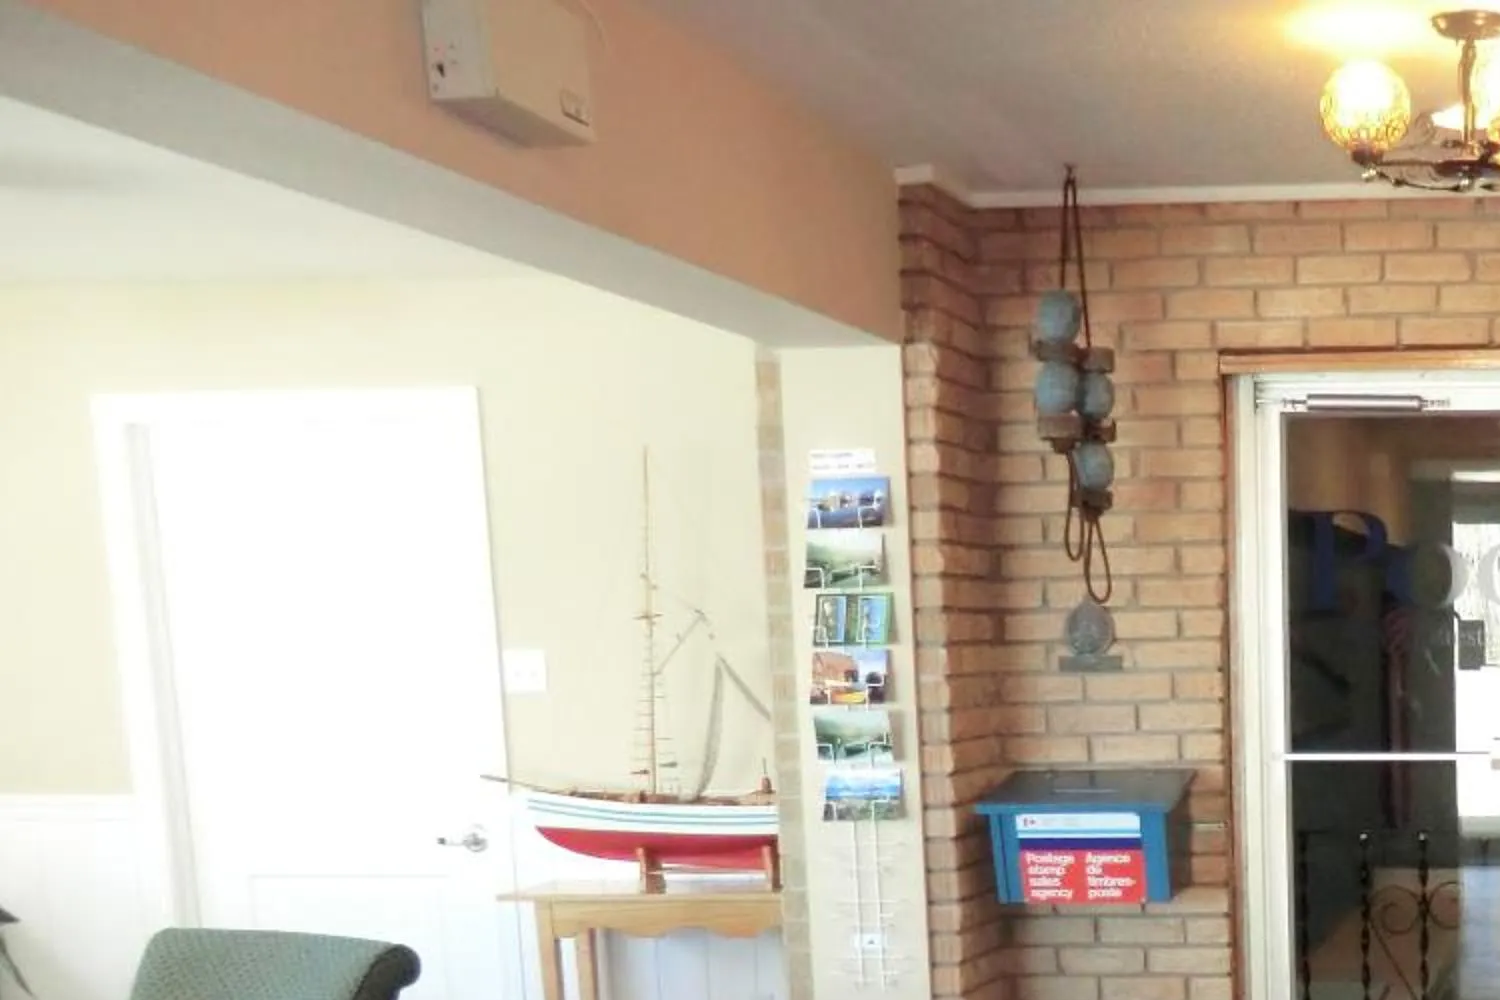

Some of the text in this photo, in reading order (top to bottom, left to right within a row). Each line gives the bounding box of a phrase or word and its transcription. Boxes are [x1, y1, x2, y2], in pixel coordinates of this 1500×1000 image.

[1025, 852, 1075, 866] Postage
[1027, 865, 1067, 877] stamp
[1085, 863, 1103, 875] de
[1031, 887, 1073, 901] agency
